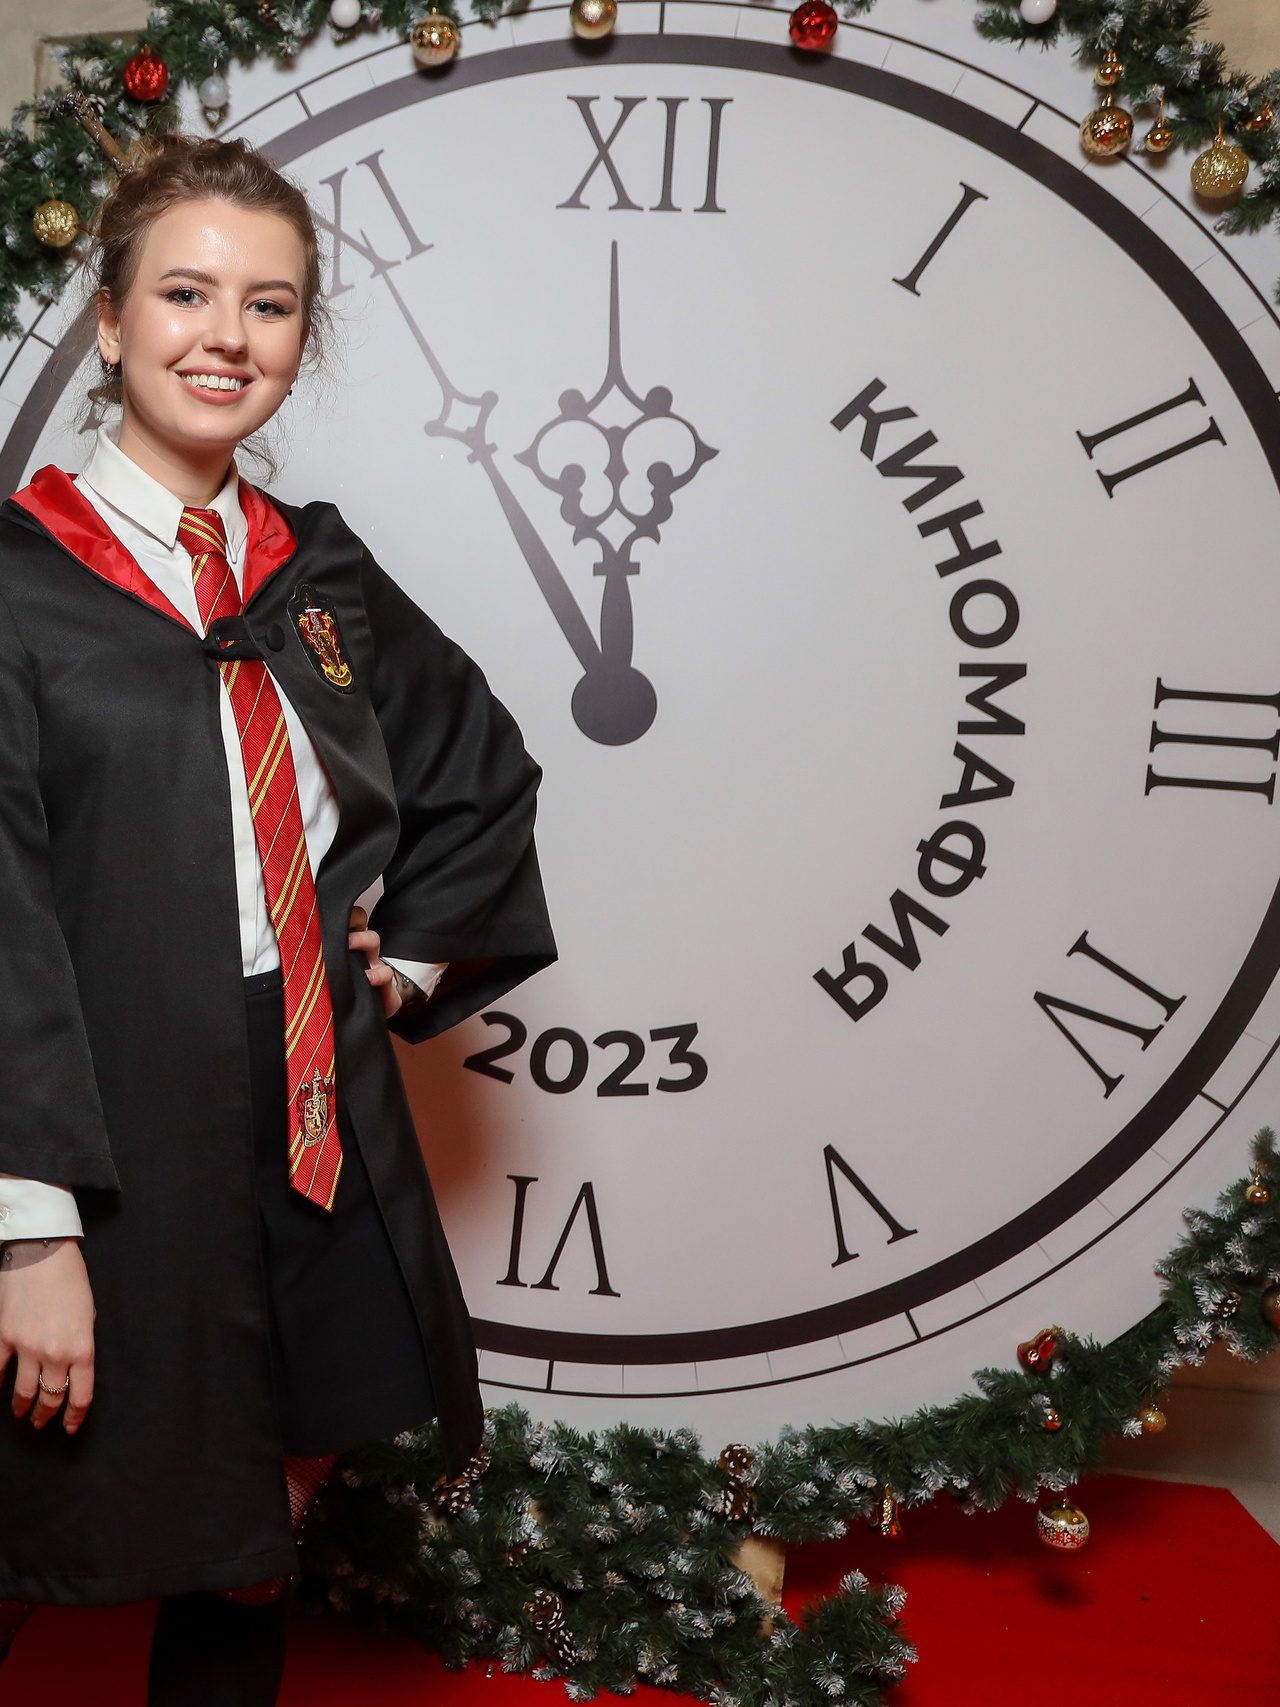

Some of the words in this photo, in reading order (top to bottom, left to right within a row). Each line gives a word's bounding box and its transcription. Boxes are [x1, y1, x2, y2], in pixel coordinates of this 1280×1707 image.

[556, 95, 734, 213] XII
[1075, 376, 1228, 499] II
[812, 377, 1029, 1024] КИНОМАФИЯ
[1144, 676, 1280, 806] III
[463, 1010, 710, 1099] 2023
[1033, 929, 1188, 1100] IV
